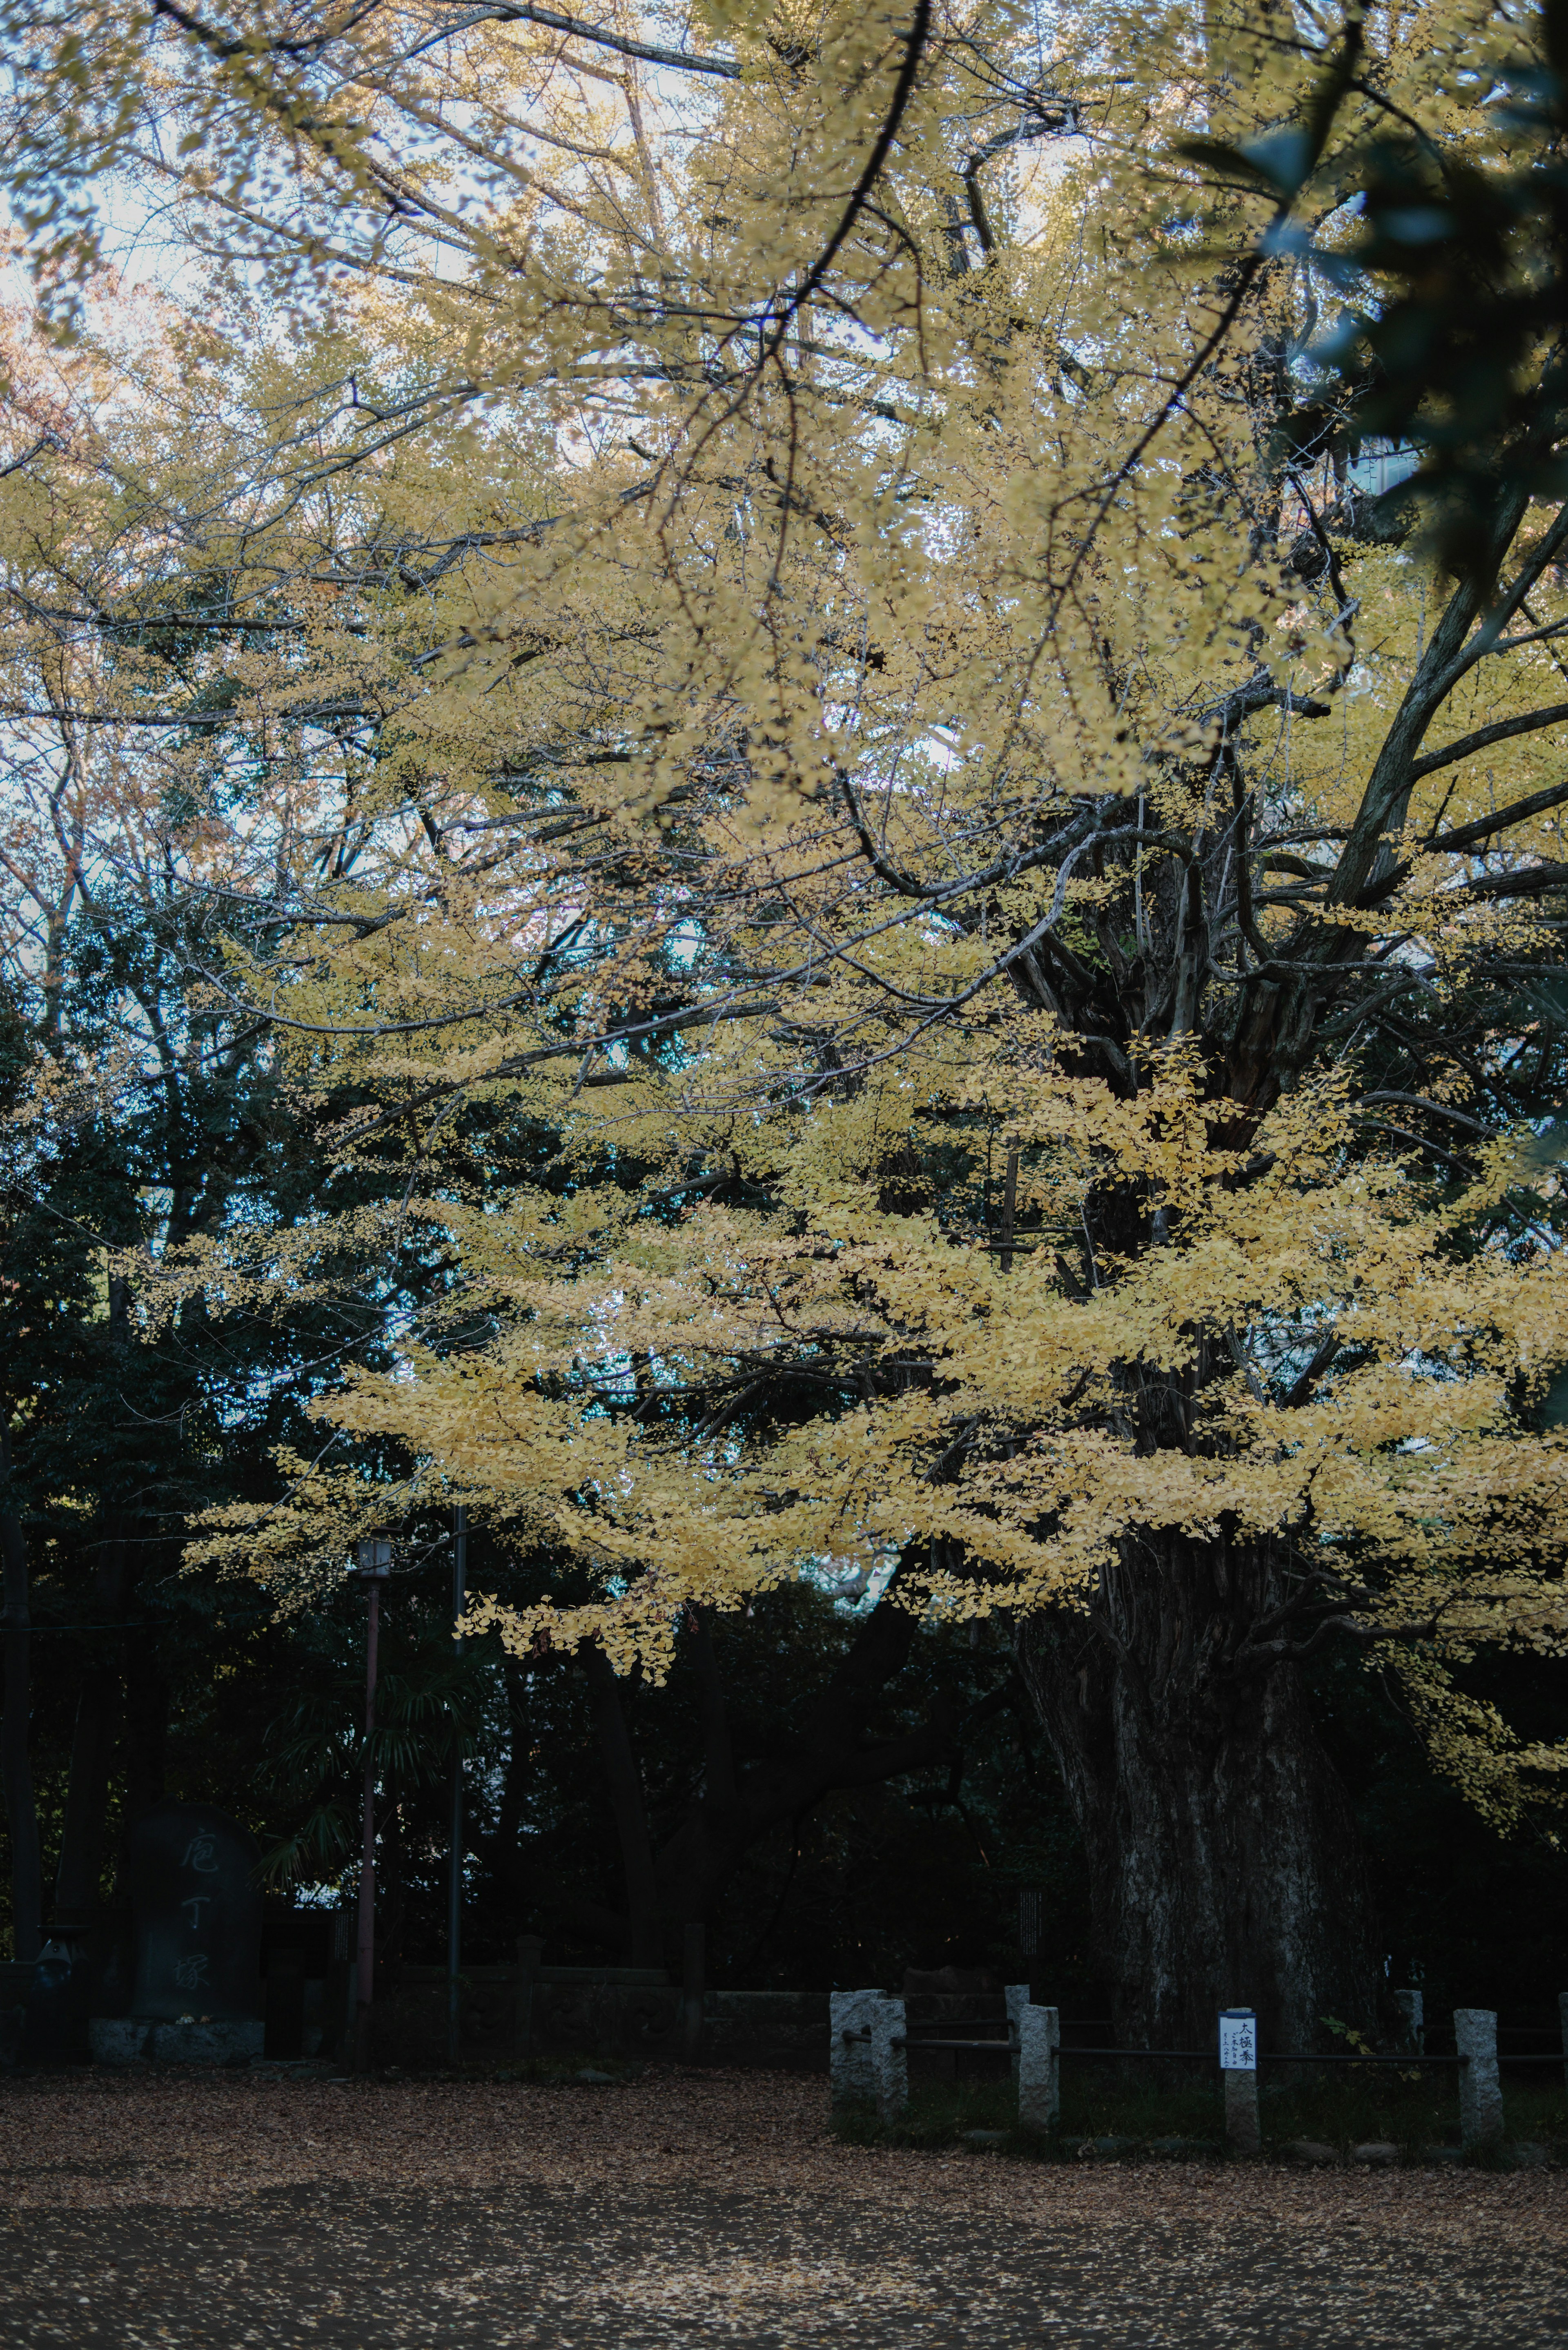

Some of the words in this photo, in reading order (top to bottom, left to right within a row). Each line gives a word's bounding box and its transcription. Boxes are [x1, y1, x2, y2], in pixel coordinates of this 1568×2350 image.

[173, 1826, 219, 1990] 庖丁塚
[1239, 2022, 1254, 2066] 太極拳
